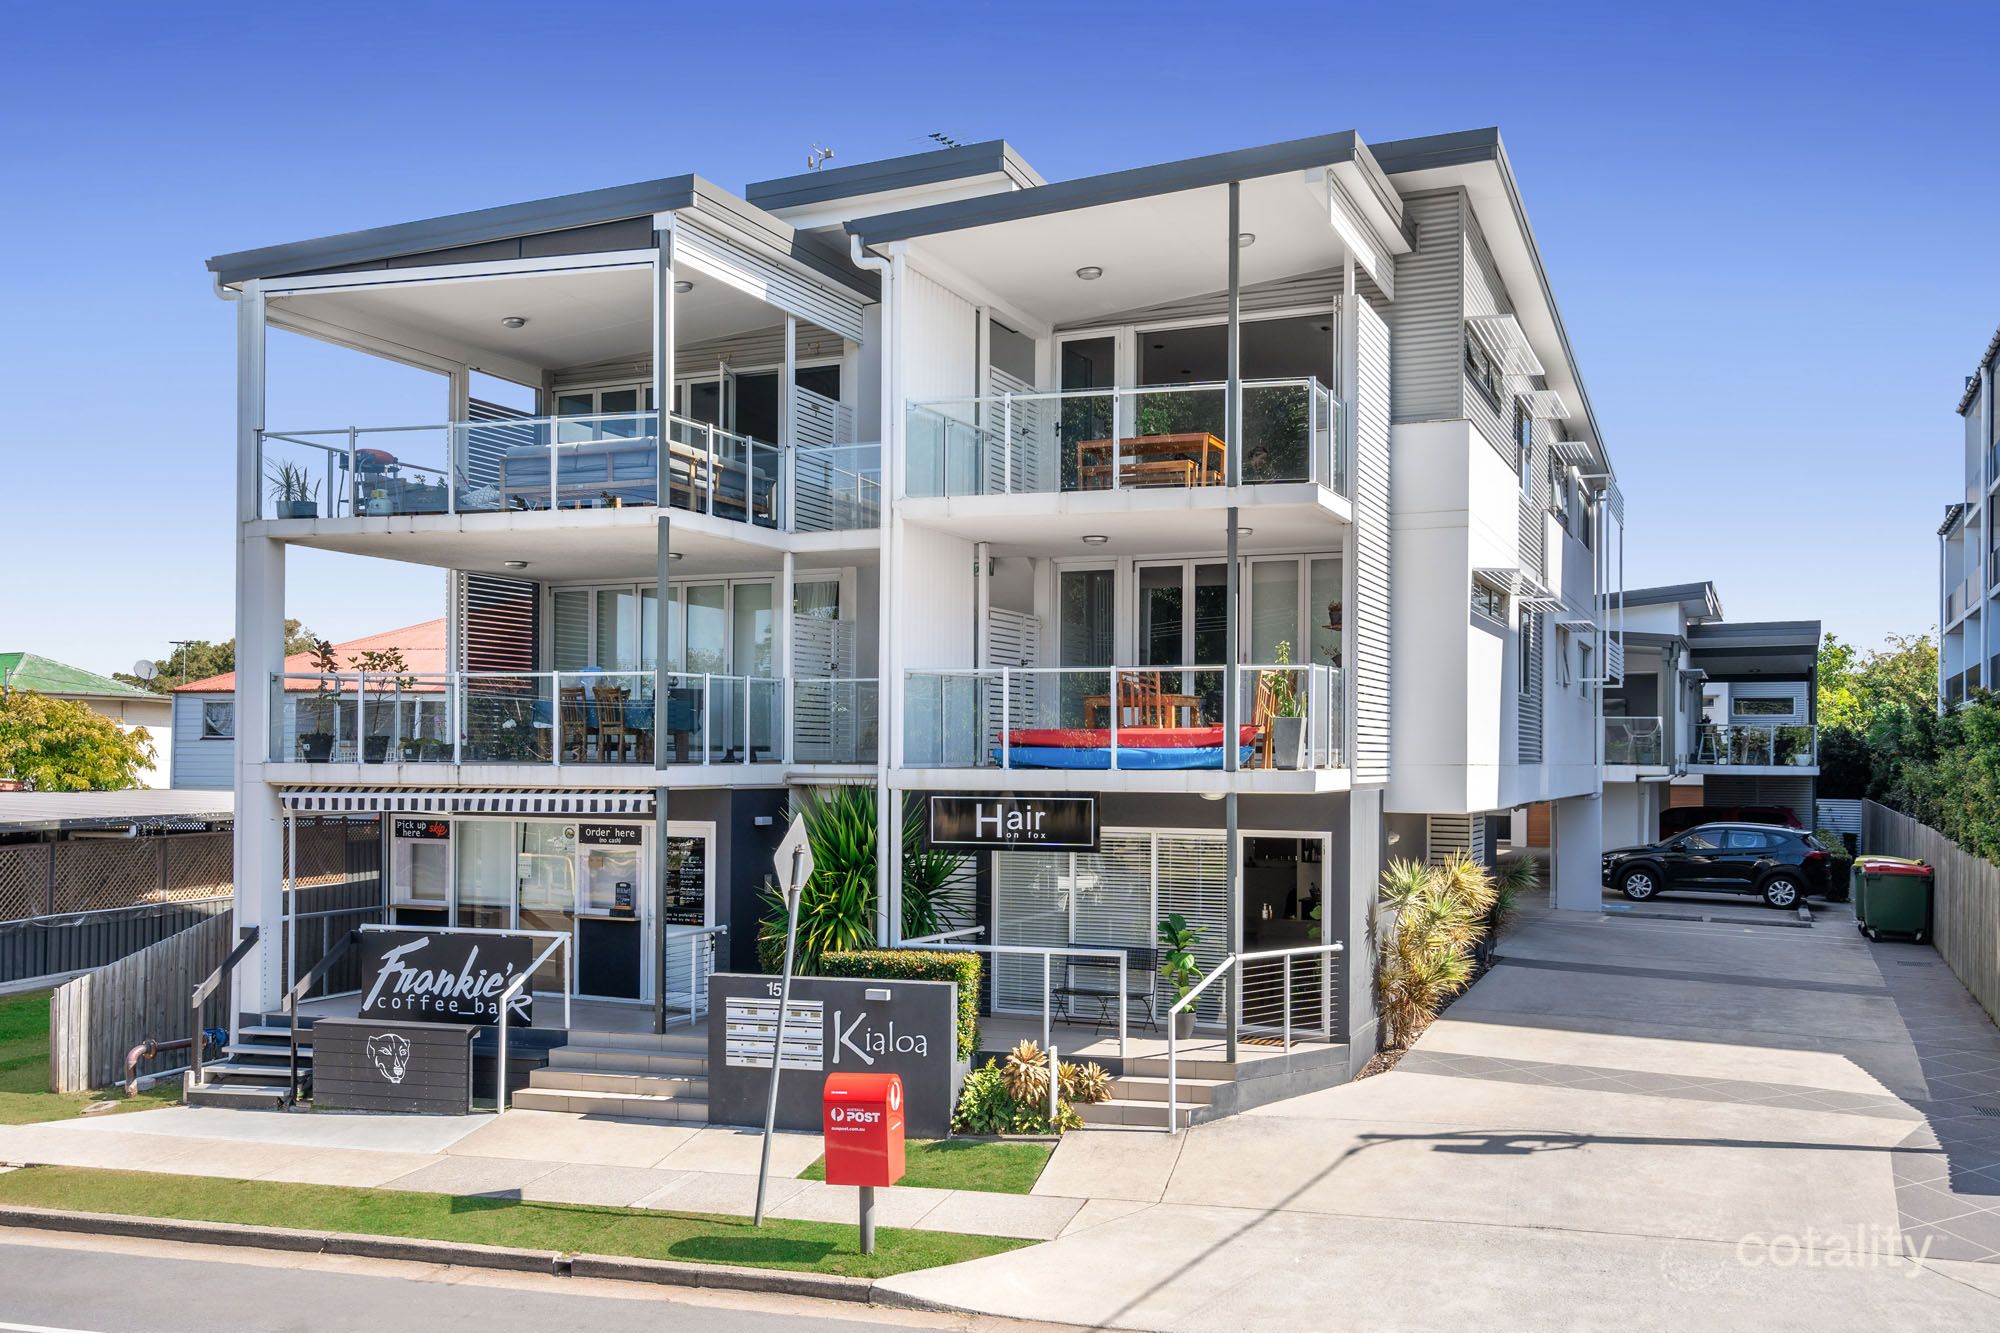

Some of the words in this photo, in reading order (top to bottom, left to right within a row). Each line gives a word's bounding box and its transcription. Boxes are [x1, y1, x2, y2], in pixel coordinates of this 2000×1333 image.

[397, 820, 414, 829] Pick
[417, 821, 427, 831] up
[975, 803, 1046, 838] Hair
[402, 829, 421, 837] here
[585, 827, 611, 837] Order
[615, 827, 635, 838] here
[1028, 831, 1046, 839] fox
[362, 936, 527, 1011] Frankie's
[766, 982, 782, 997] 15
[832, 1010, 928, 1066] Kialoa
[846, 1112, 880, 1123] POST
